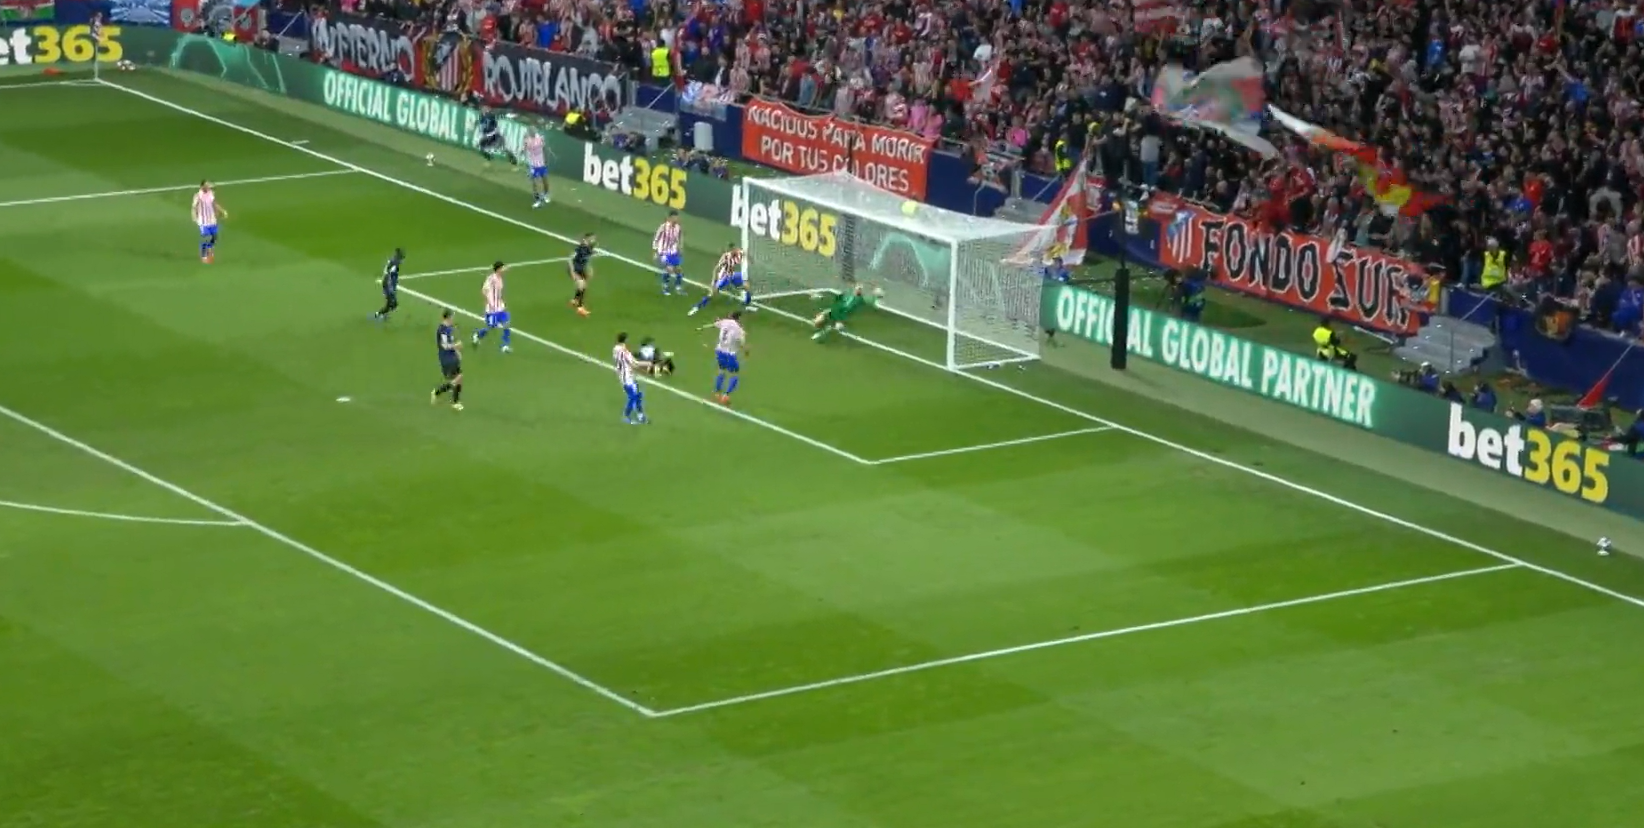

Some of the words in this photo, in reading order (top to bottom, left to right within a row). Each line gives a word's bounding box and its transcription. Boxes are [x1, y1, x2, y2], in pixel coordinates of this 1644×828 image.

[323, 70, 391, 122] OFFICIAL
[397, 90, 459, 142] GLOBAL
[583, 141, 688, 211] bet365
[761, 136, 795, 165] POR
[799, 145, 829, 173] TUS
[730, 184, 837, 258] bet365
[1199, 217, 1322, 304] FONDO
[1162, 317, 1253, 389] GLOBAL
[1260, 345, 1376, 428] PARTNER
[1447, 402, 1610, 504] bet365
